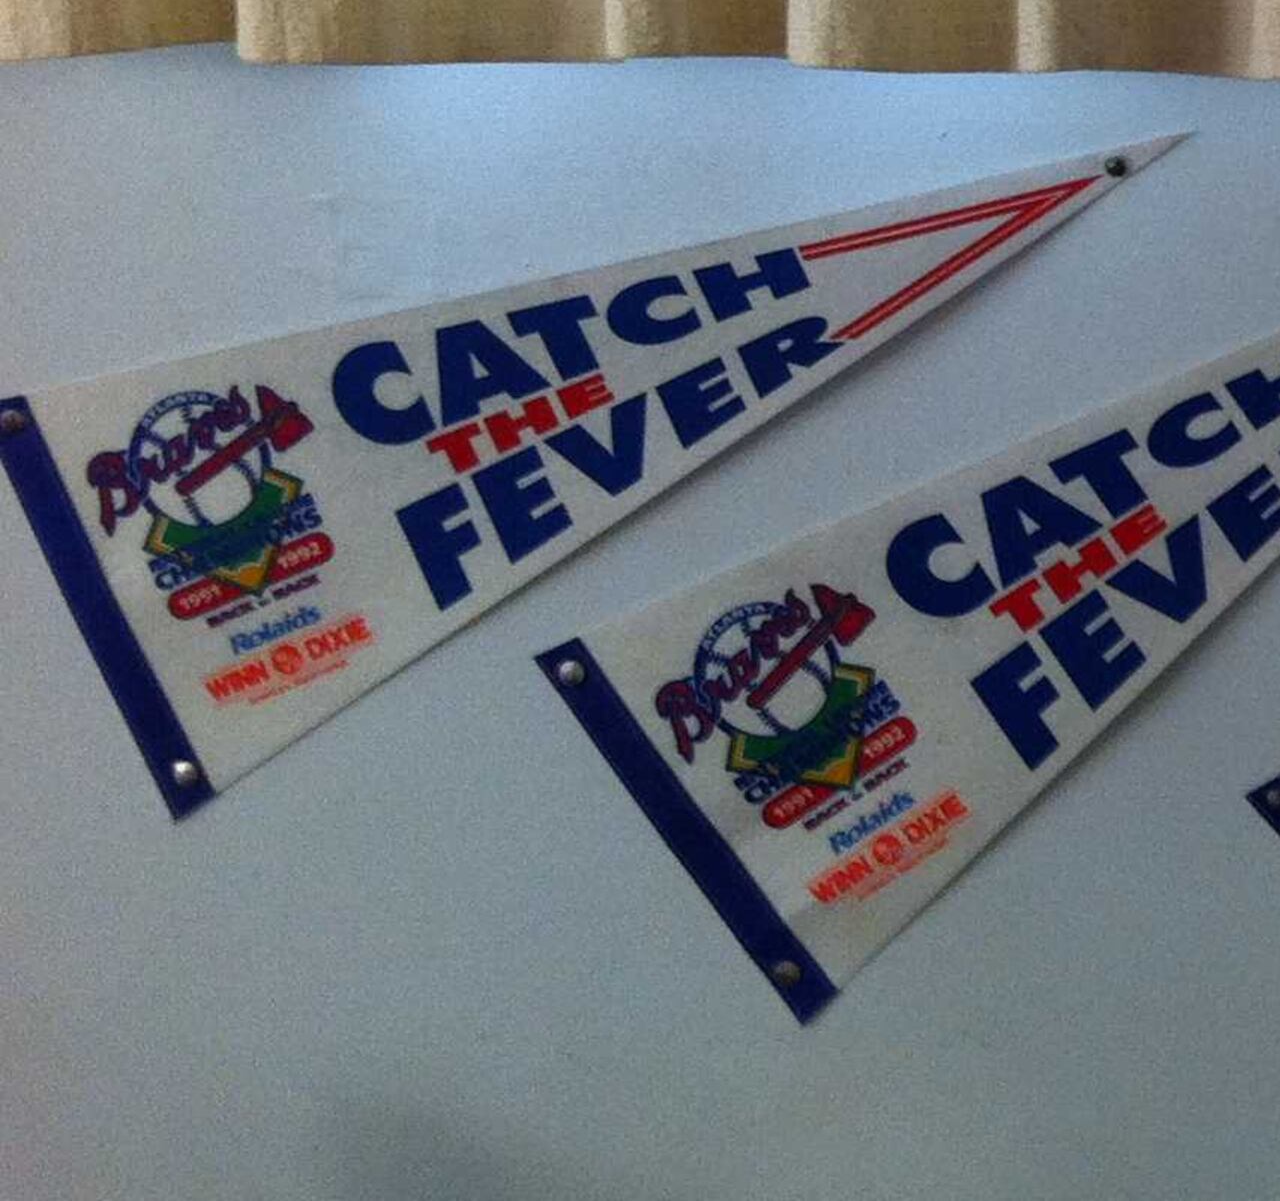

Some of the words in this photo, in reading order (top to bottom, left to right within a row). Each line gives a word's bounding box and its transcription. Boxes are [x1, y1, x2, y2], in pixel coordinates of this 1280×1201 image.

[332, 247, 811, 445] CATCH
[87, 385, 250, 537] Braves
[395, 315, 843, 610] FEVER
[427, 372, 615, 474] THE
[990, 504, 1167, 634] THE
[206, 662, 268, 698] WINN
[304, 617, 369, 659] DIXIE
[231, 606, 320, 655] Rolaids
[656, 588, 810, 764] Braves
[810, 856, 872, 902] WINN
[903, 793, 967, 842] DIXIE
[829, 792, 914, 854] Rolaids
